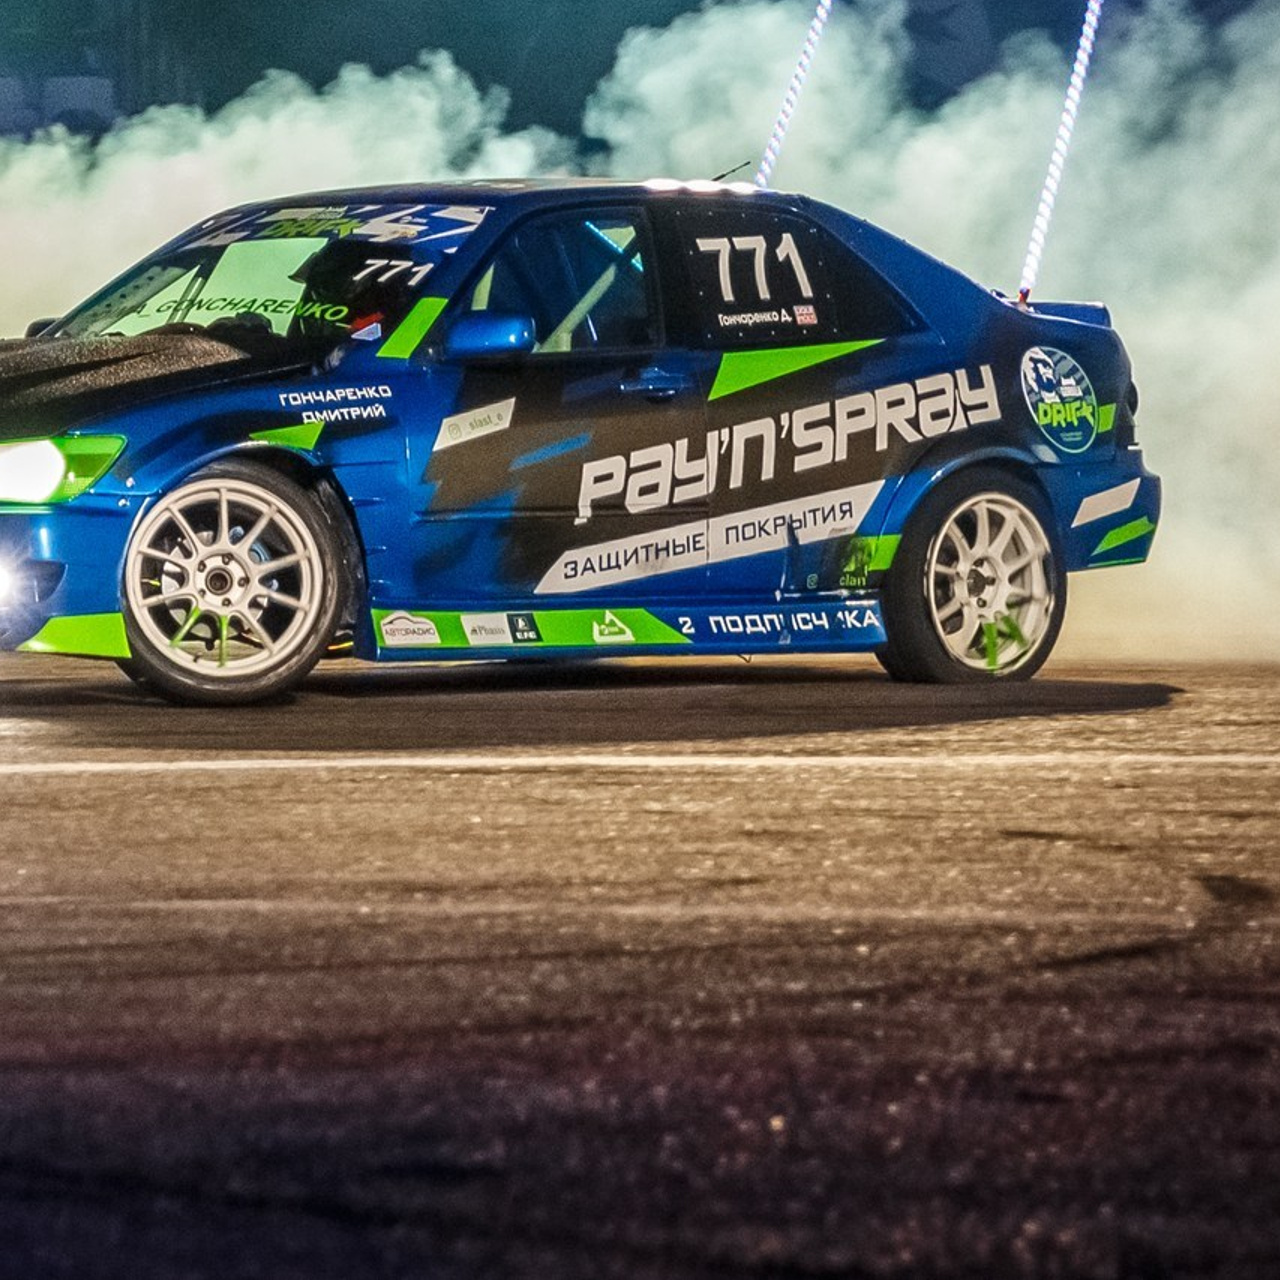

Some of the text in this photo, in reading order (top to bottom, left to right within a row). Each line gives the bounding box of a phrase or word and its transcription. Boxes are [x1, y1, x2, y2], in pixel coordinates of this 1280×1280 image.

[352, 259, 435, 286] 771
[696, 233, 813, 302] 771
[718, 310, 779, 327] Гончаренко
[279, 384, 393, 407] ГОНЧАРЕНКО
[301, 403, 387, 424] ДМИТРИЙ
[563, 500, 854, 580] ЗАЩИТНЫЕ ПОКРЫТИЯ
[384, 627, 436, 638] АВТОРАДИО
